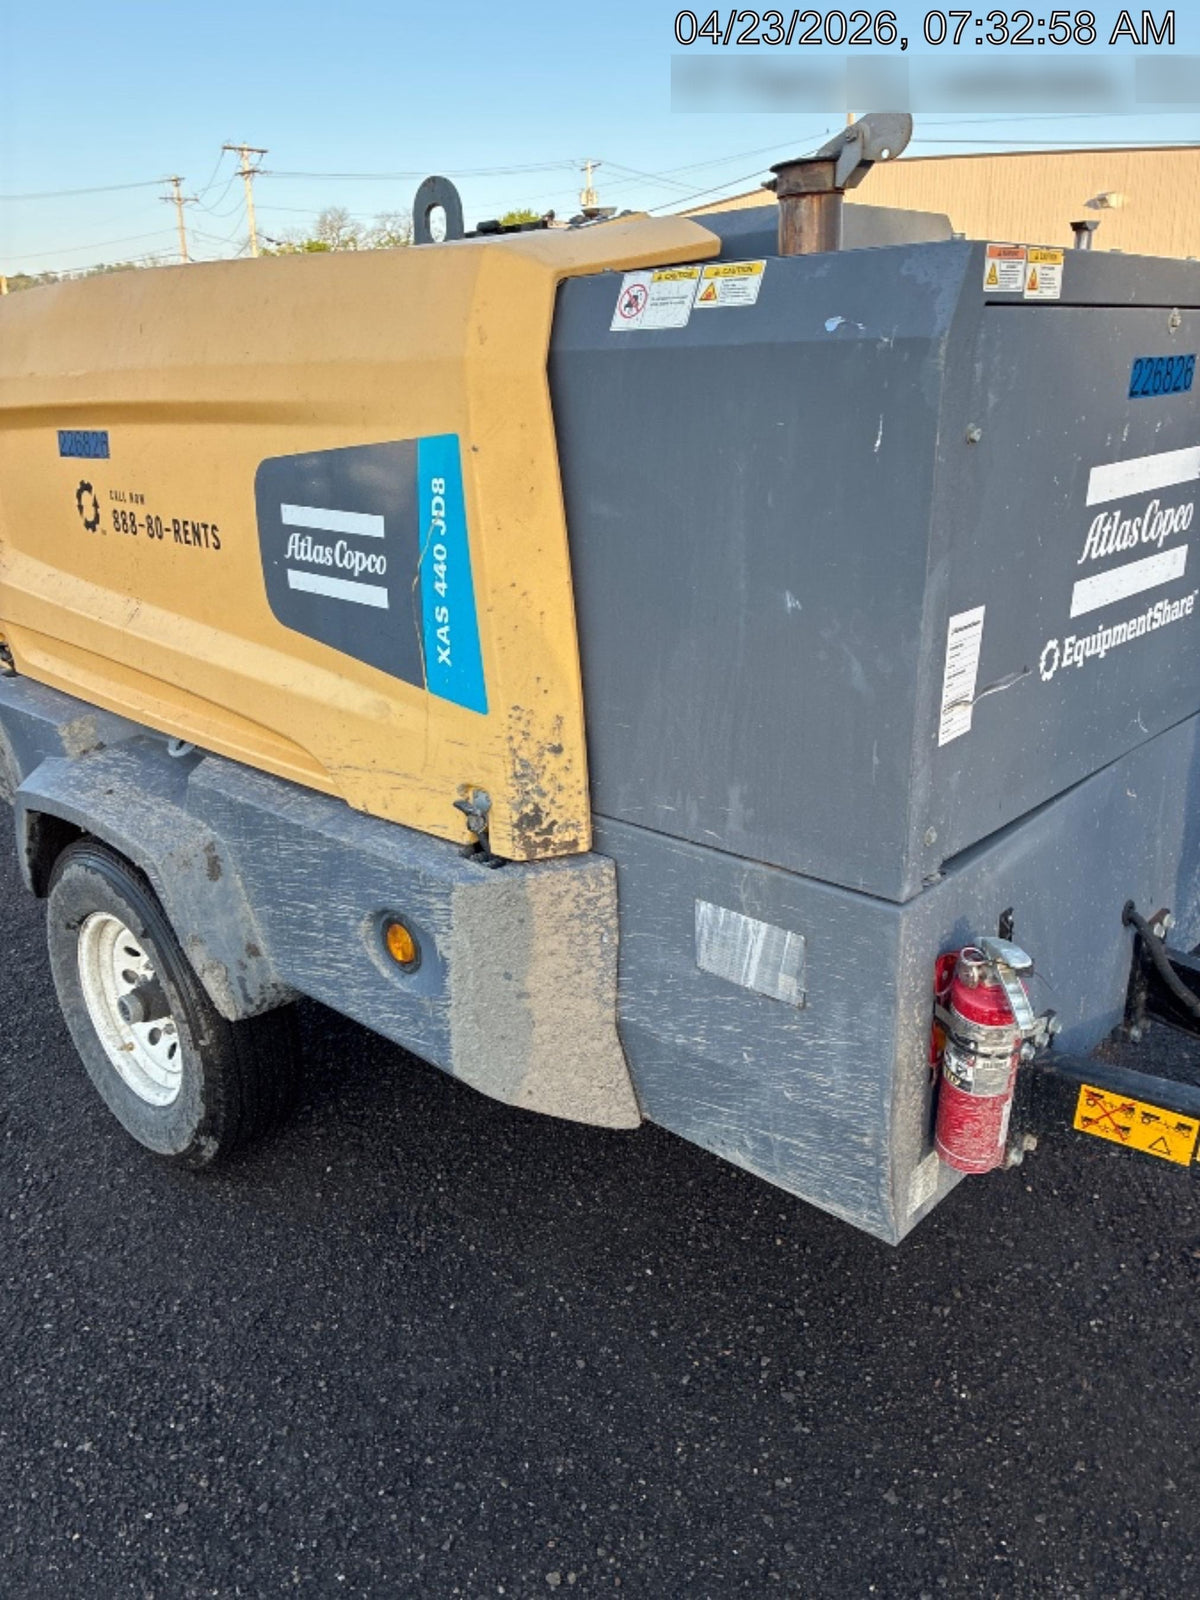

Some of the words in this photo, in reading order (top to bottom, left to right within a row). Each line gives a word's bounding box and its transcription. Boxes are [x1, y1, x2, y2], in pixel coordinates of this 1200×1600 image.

[1130, 355, 1195, 397] 226826
[109, 490, 127, 503] CALL
[129, 492, 145, 505] NOW
[431, 477, 447, 536] JD8
[112, 509, 221, 550] 888-80-RENTS
[433, 543, 449, 598] 440
[435, 606, 452, 667] XAS
[1061, 596, 1194, 667] EquipmentShare
